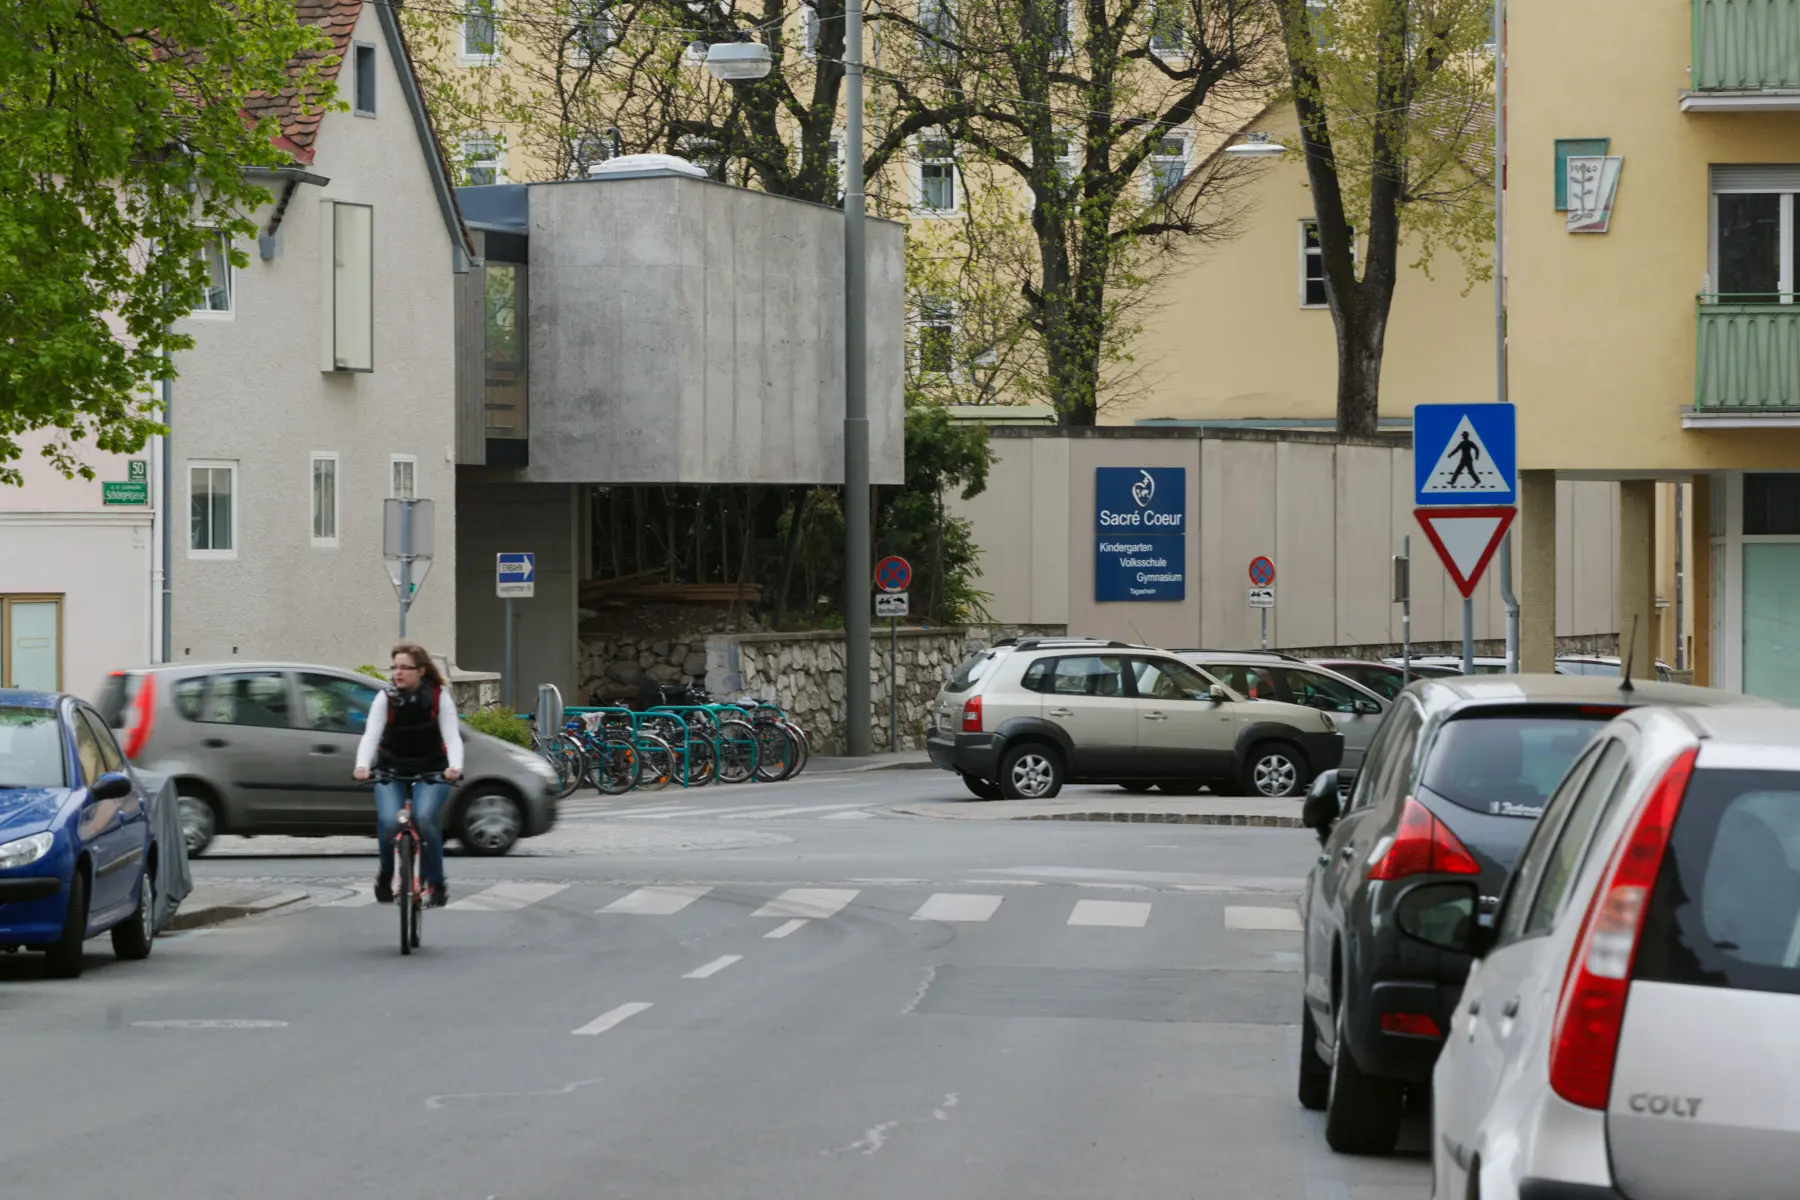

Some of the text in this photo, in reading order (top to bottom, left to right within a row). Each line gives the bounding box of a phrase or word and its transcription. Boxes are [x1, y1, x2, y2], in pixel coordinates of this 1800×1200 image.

[132, 462, 144, 474] 50
[1100, 509, 1182, 526] Sacré Coeur
[1100, 543, 1153, 554] Kindergarten
[502, 563, 523, 572] EINBAHN
[1119, 557, 1167, 568] Volksschule
[1136, 571, 1182, 584] Gymnasium
[1628, 1092, 1702, 1118] COLT
